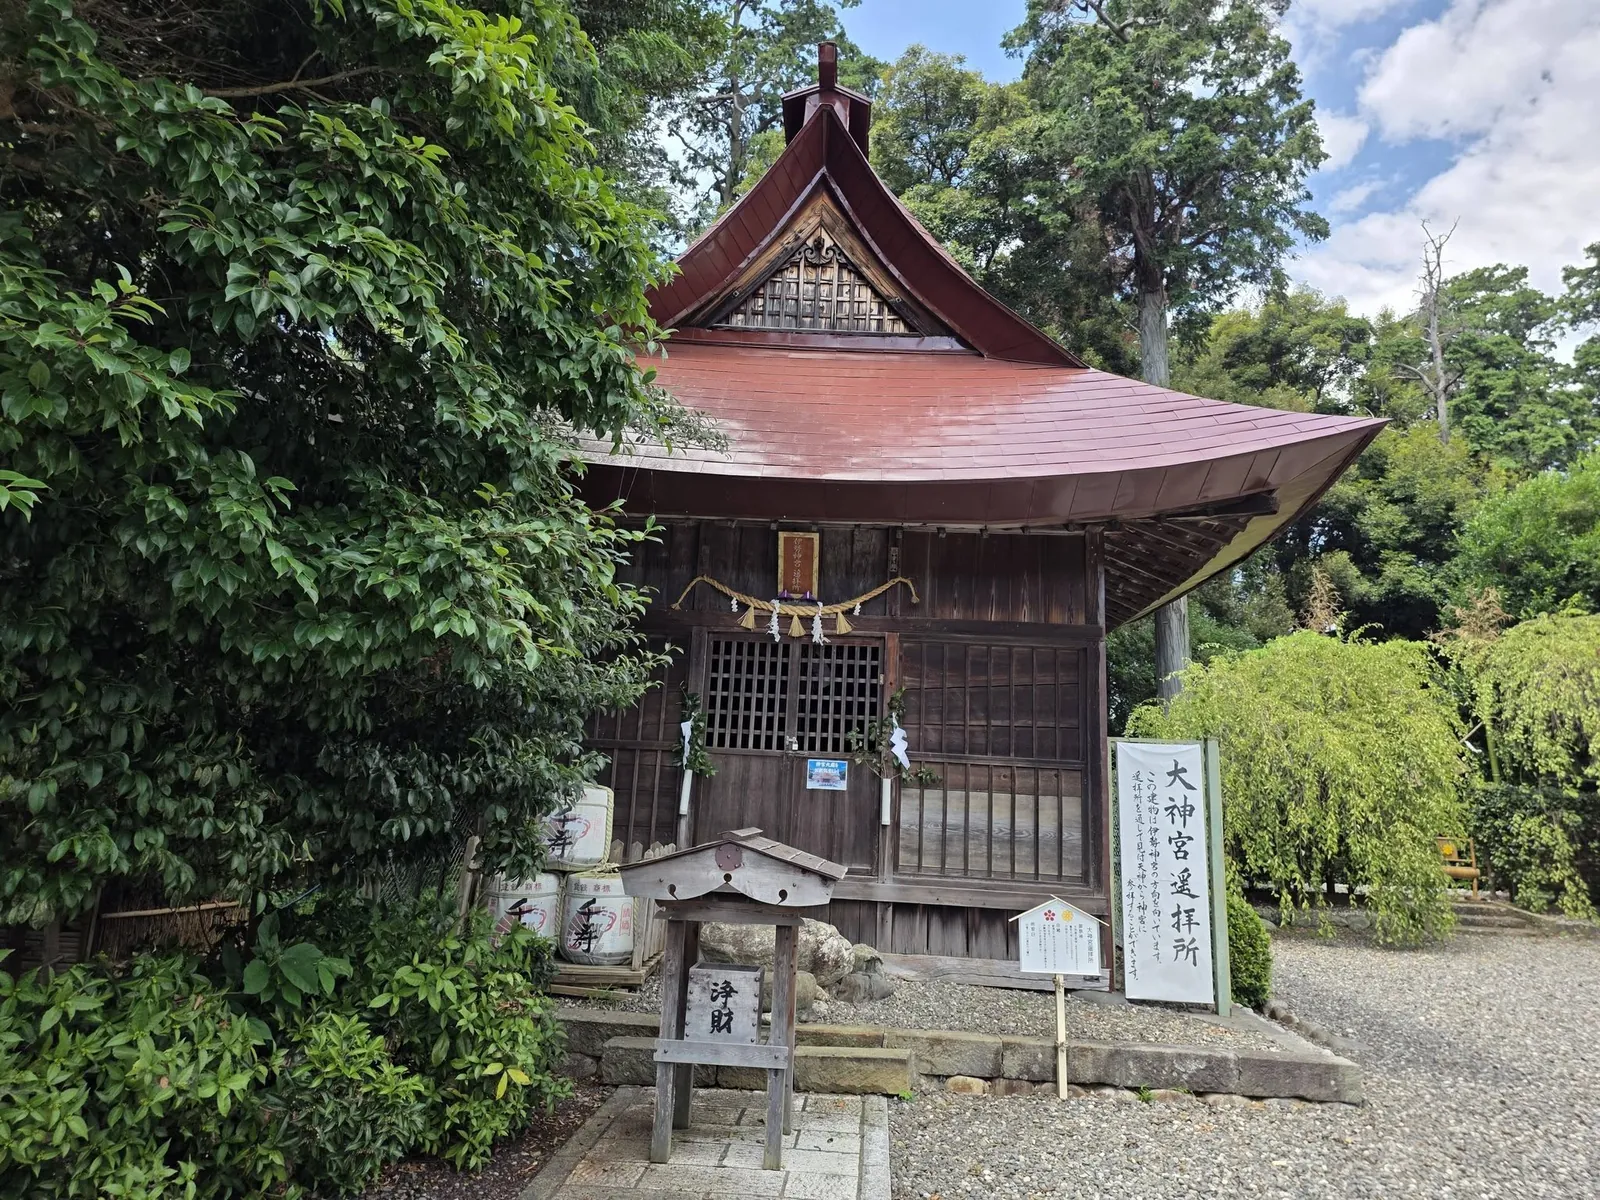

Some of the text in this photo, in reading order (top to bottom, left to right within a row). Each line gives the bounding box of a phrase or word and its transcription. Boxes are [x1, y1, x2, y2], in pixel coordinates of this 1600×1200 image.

[1164, 759, 1201, 968] 大神宮遥拝所
[573, 897, 604, 954] 千寿
[709, 979, 739, 1034] 浄財
